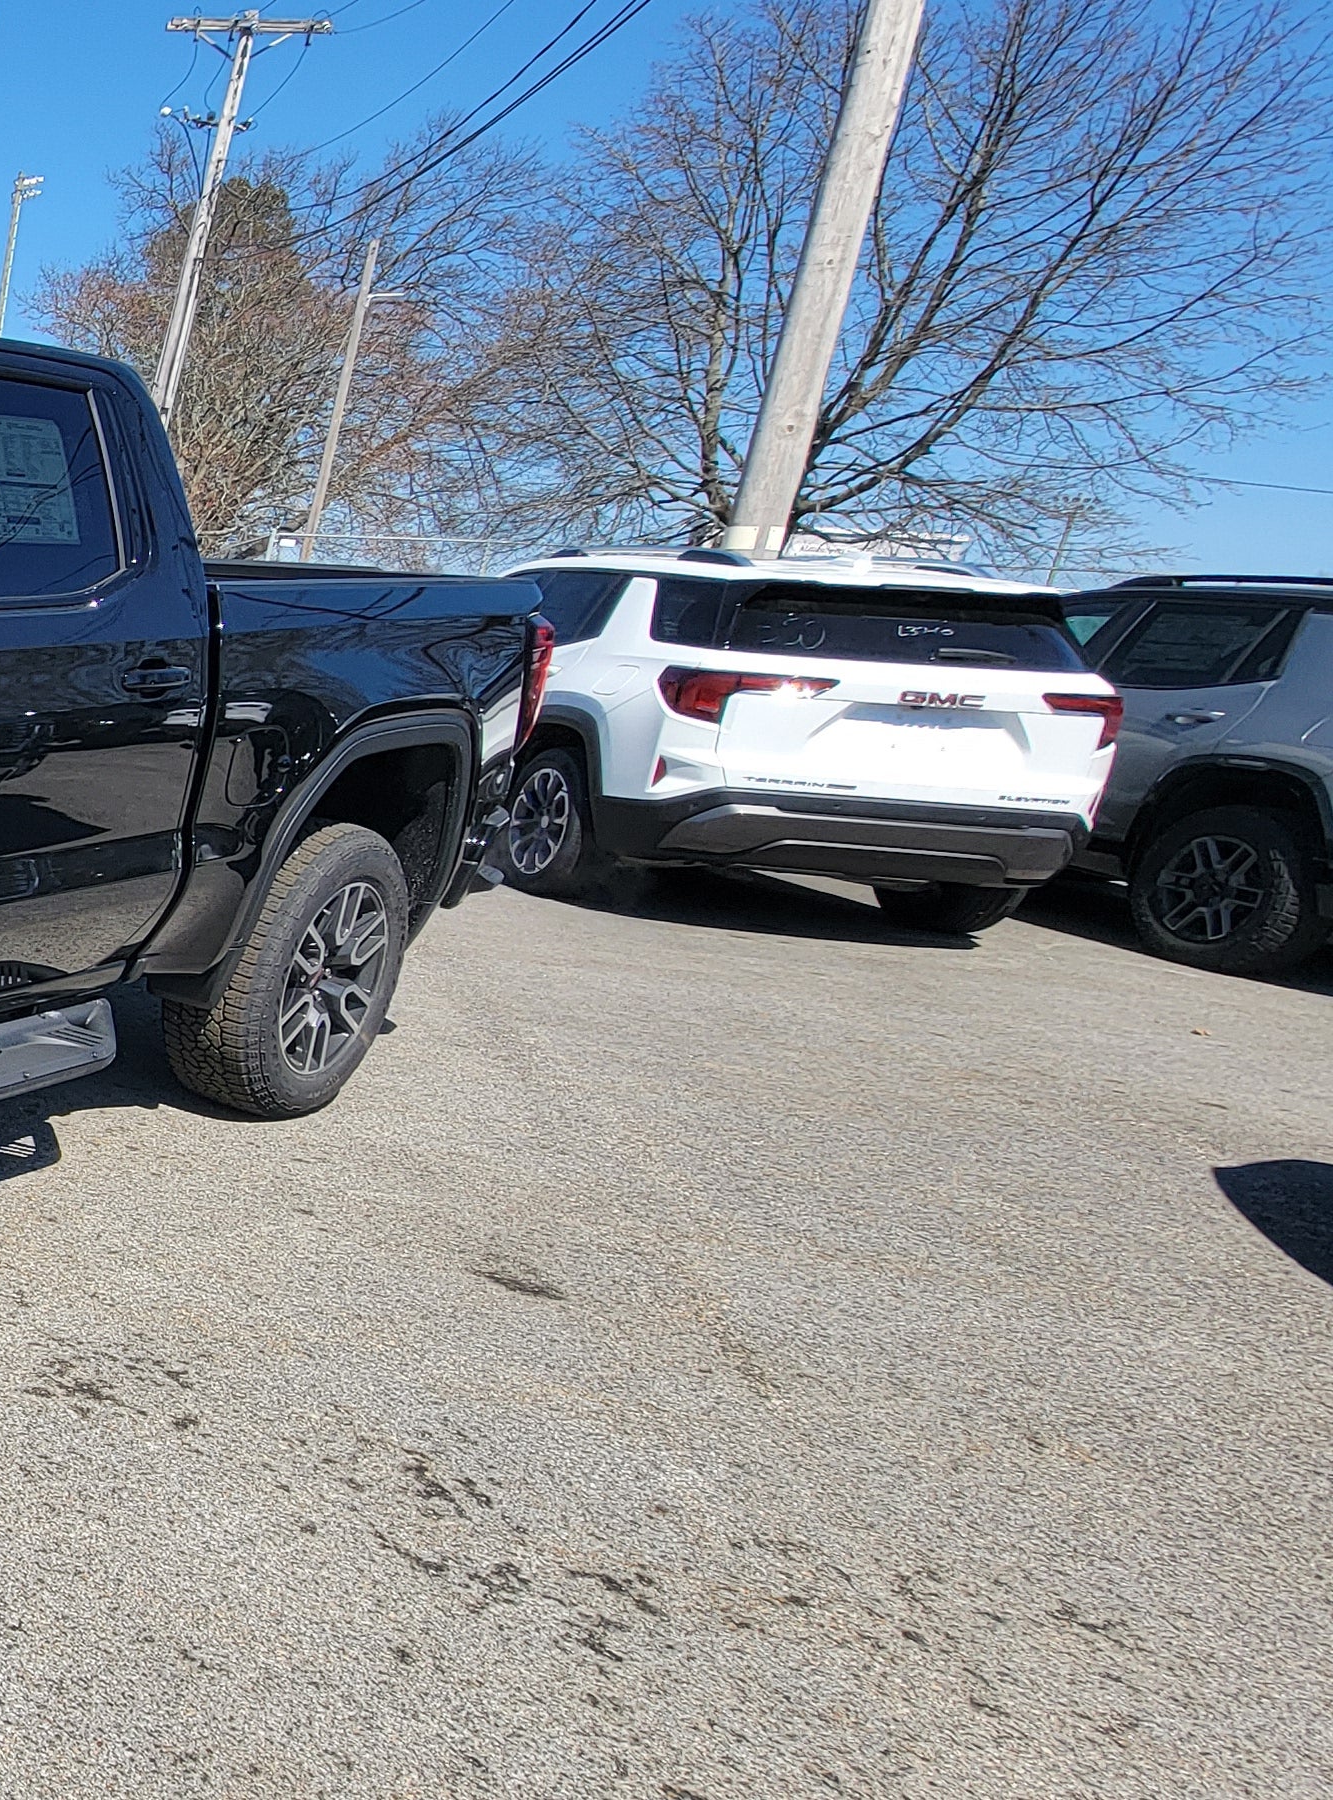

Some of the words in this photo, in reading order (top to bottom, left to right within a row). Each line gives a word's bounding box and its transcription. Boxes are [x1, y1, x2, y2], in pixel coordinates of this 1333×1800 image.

[898, 690, 986, 708] GMC
[742, 776, 825, 788] TERRAIN
[997, 795, 1071, 805] ELEVATION
